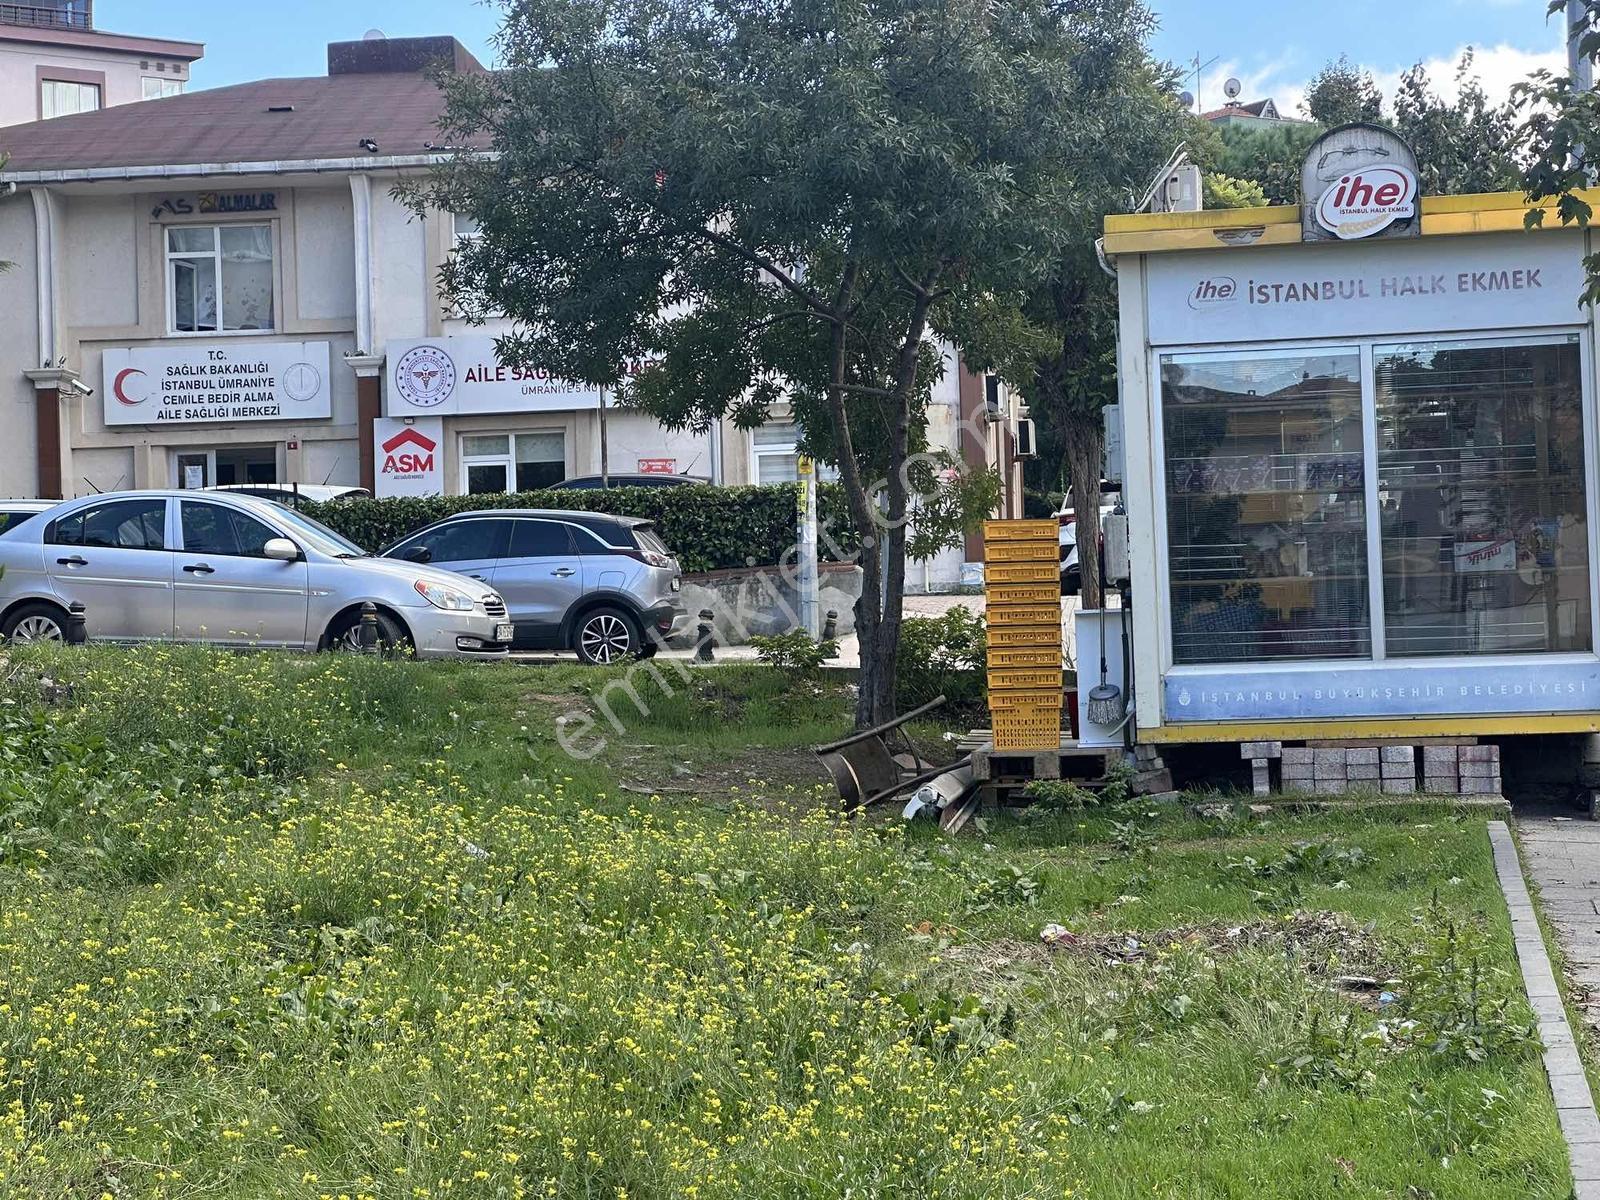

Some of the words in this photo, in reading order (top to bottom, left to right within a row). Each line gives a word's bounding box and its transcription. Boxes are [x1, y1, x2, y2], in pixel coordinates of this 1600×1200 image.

[1333, 176, 1400, 208] ihe
[1195, 280, 1232, 299] ihe
[1248, 279, 1370, 304] İSTANBUL
[1380, 274, 1447, 297] HALK
[1457, 268, 1543, 293] EKMEK
[207, 350, 227, 360] T.C.
[166, 364, 207, 376] SAĞLIK
[209, 363, 269, 375] BAKANLIĞI
[463, 364, 506, 383] AİLE
[161, 380, 216, 391] İSTANBUL
[219, 376, 275, 389] ÜMRANİYE
[520, 383, 573, 396] ÜMRANİYE
[575, 383, 581, 394] 5
[162, 393, 204, 405] CEMİLE
[207, 392, 241, 404] BEDİR
[243, 391, 274, 402] ALMA
[156, 408, 182, 420] AİLE
[184, 405, 229, 419] SAĞLIĞI
[232, 403, 281, 417] MERKEZİ
[381, 453, 434, 473] ASM
[1201, 689, 1300, 702] İSTANBUL
[1460, 680, 1585, 696] BELEDİYESİ
